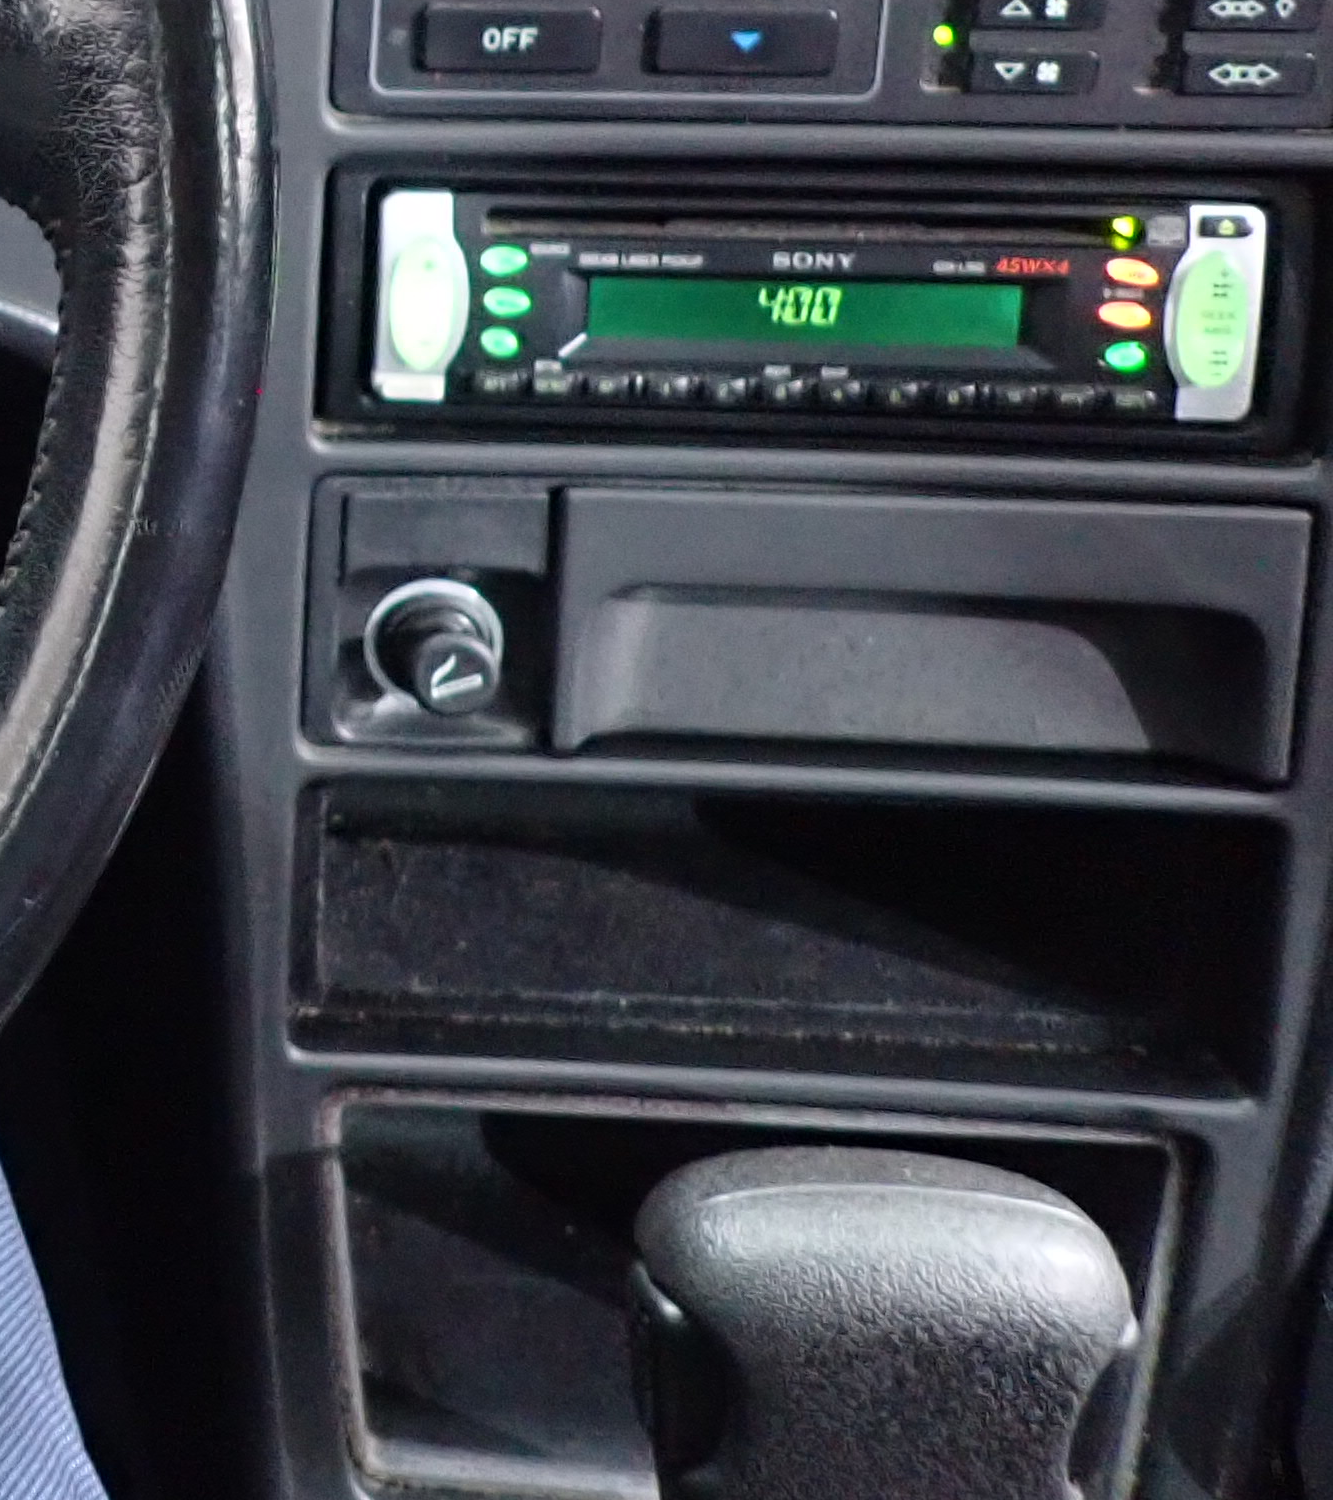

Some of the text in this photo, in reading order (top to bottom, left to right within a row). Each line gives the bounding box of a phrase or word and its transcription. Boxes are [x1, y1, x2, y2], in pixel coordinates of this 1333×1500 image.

[482, 27, 539, 52] OFF
[773, 251, 856, 271] SONY
[759, 285, 842, 327] 400
